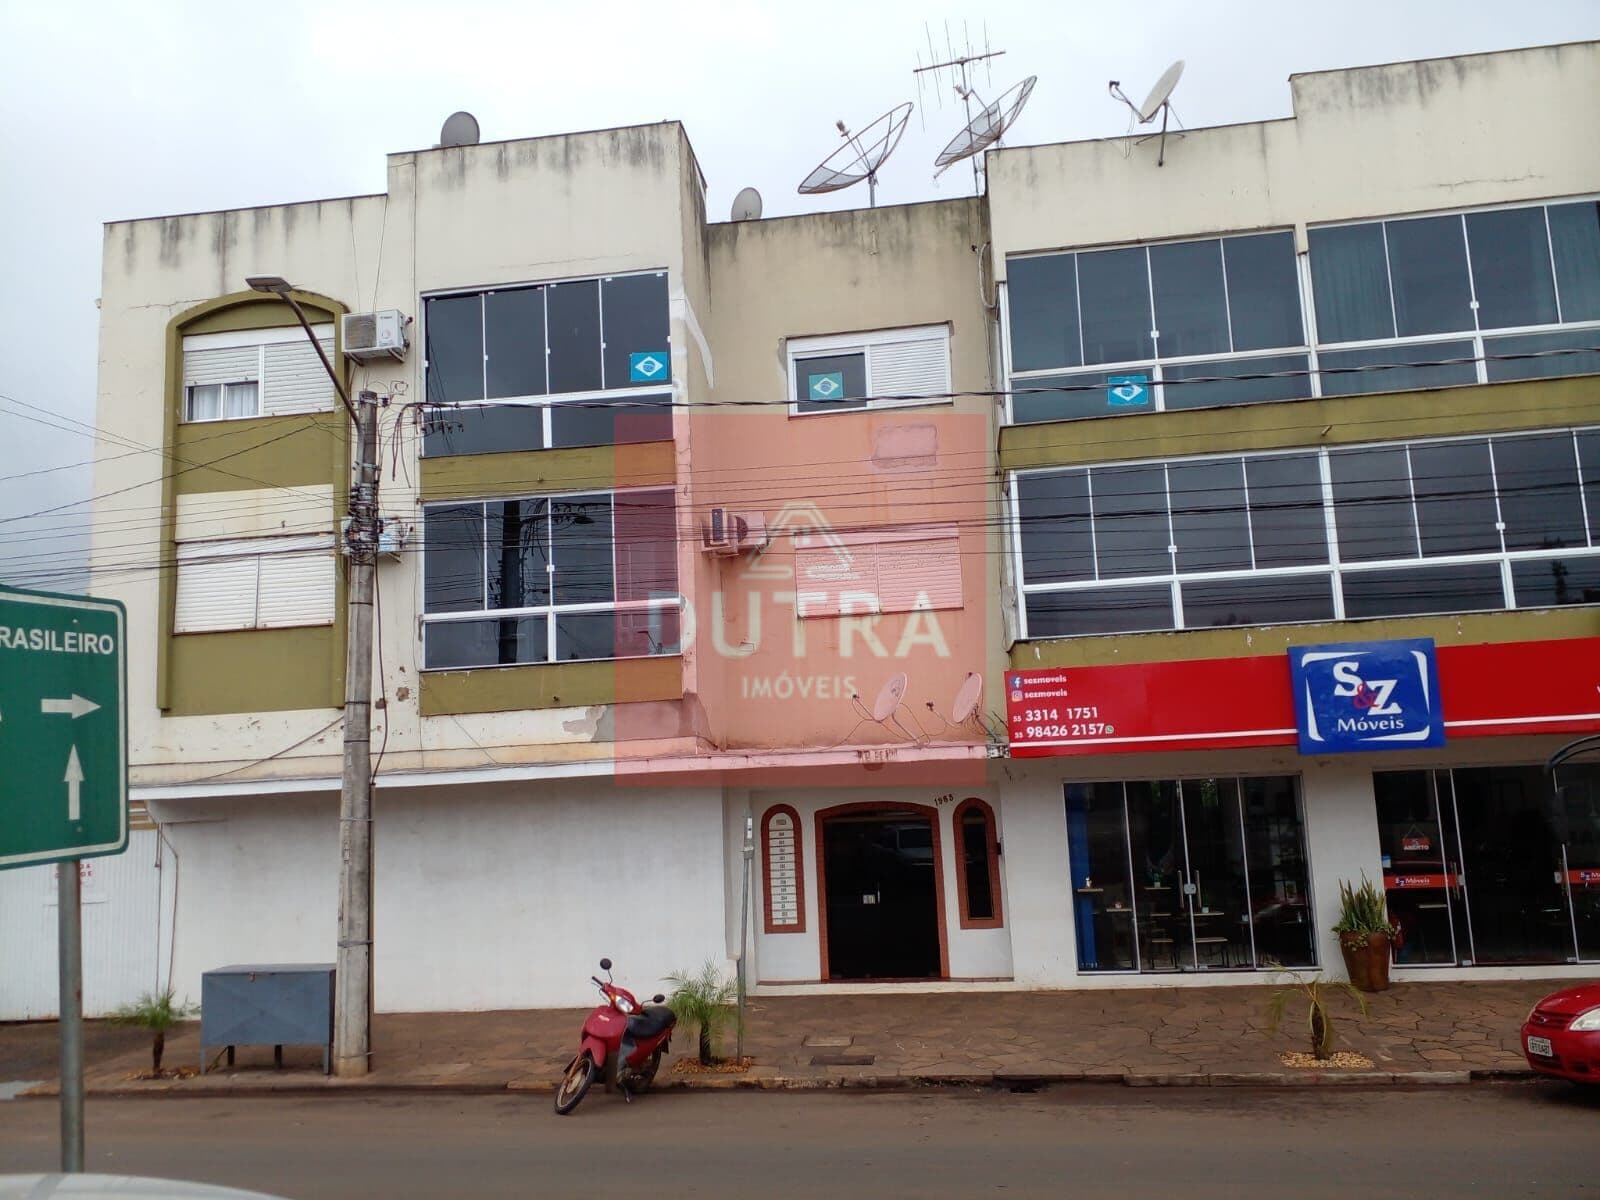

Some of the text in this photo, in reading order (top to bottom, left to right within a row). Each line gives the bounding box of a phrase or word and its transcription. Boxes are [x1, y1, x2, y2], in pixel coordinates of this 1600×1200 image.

[1025, 709, 1058, 722] 3314
[1066, 707, 1098, 720] 1751
[1026, 725, 1068, 738] 98426
[1071, 723, 1105, 736] 2157
[1337, 716, 1404, 732] Móveis
